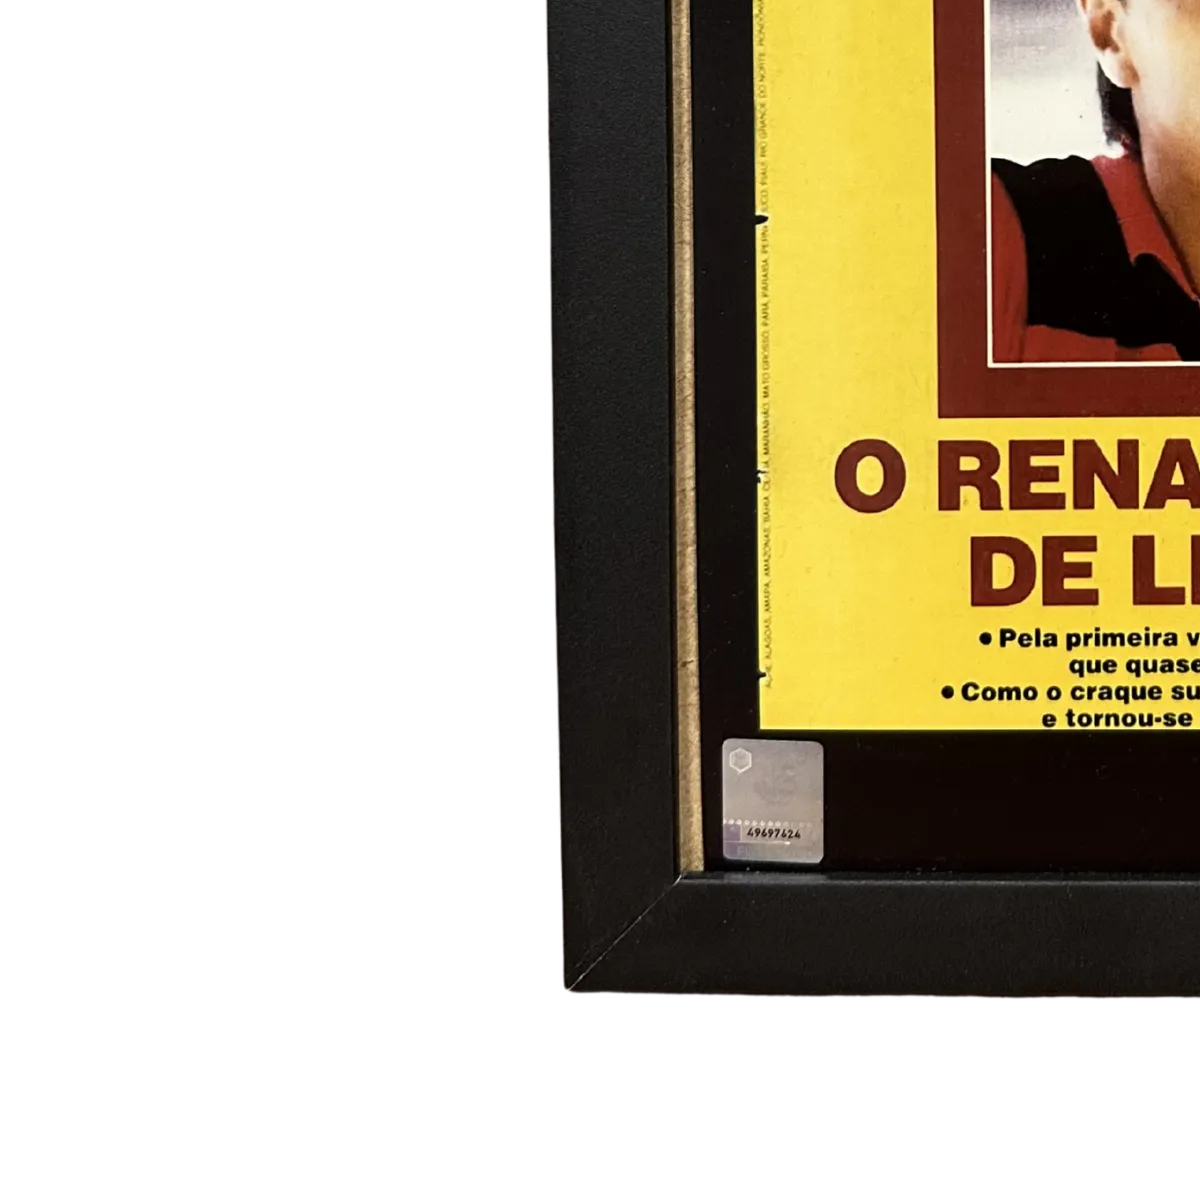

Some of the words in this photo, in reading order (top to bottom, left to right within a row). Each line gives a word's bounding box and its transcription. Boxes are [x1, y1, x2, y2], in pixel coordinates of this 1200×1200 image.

[758, 85, 766, 98] DO
[759, 102, 767, 139] GRANDE
[835, 439, 906, 513] O
[971, 536, 1099, 606] DE
[1000, 628, 1057, 647] Pela
[1066, 627, 1177, 651] primeira
[1069, 660, 1117, 678] que
[962, 682, 1038, 701] Como
[1047, 686, 1061, 700] o
[1071, 686, 1162, 704] craque
[1042, 714, 1056, 727] e
[1066, 709, 1192, 727] tornou-se
